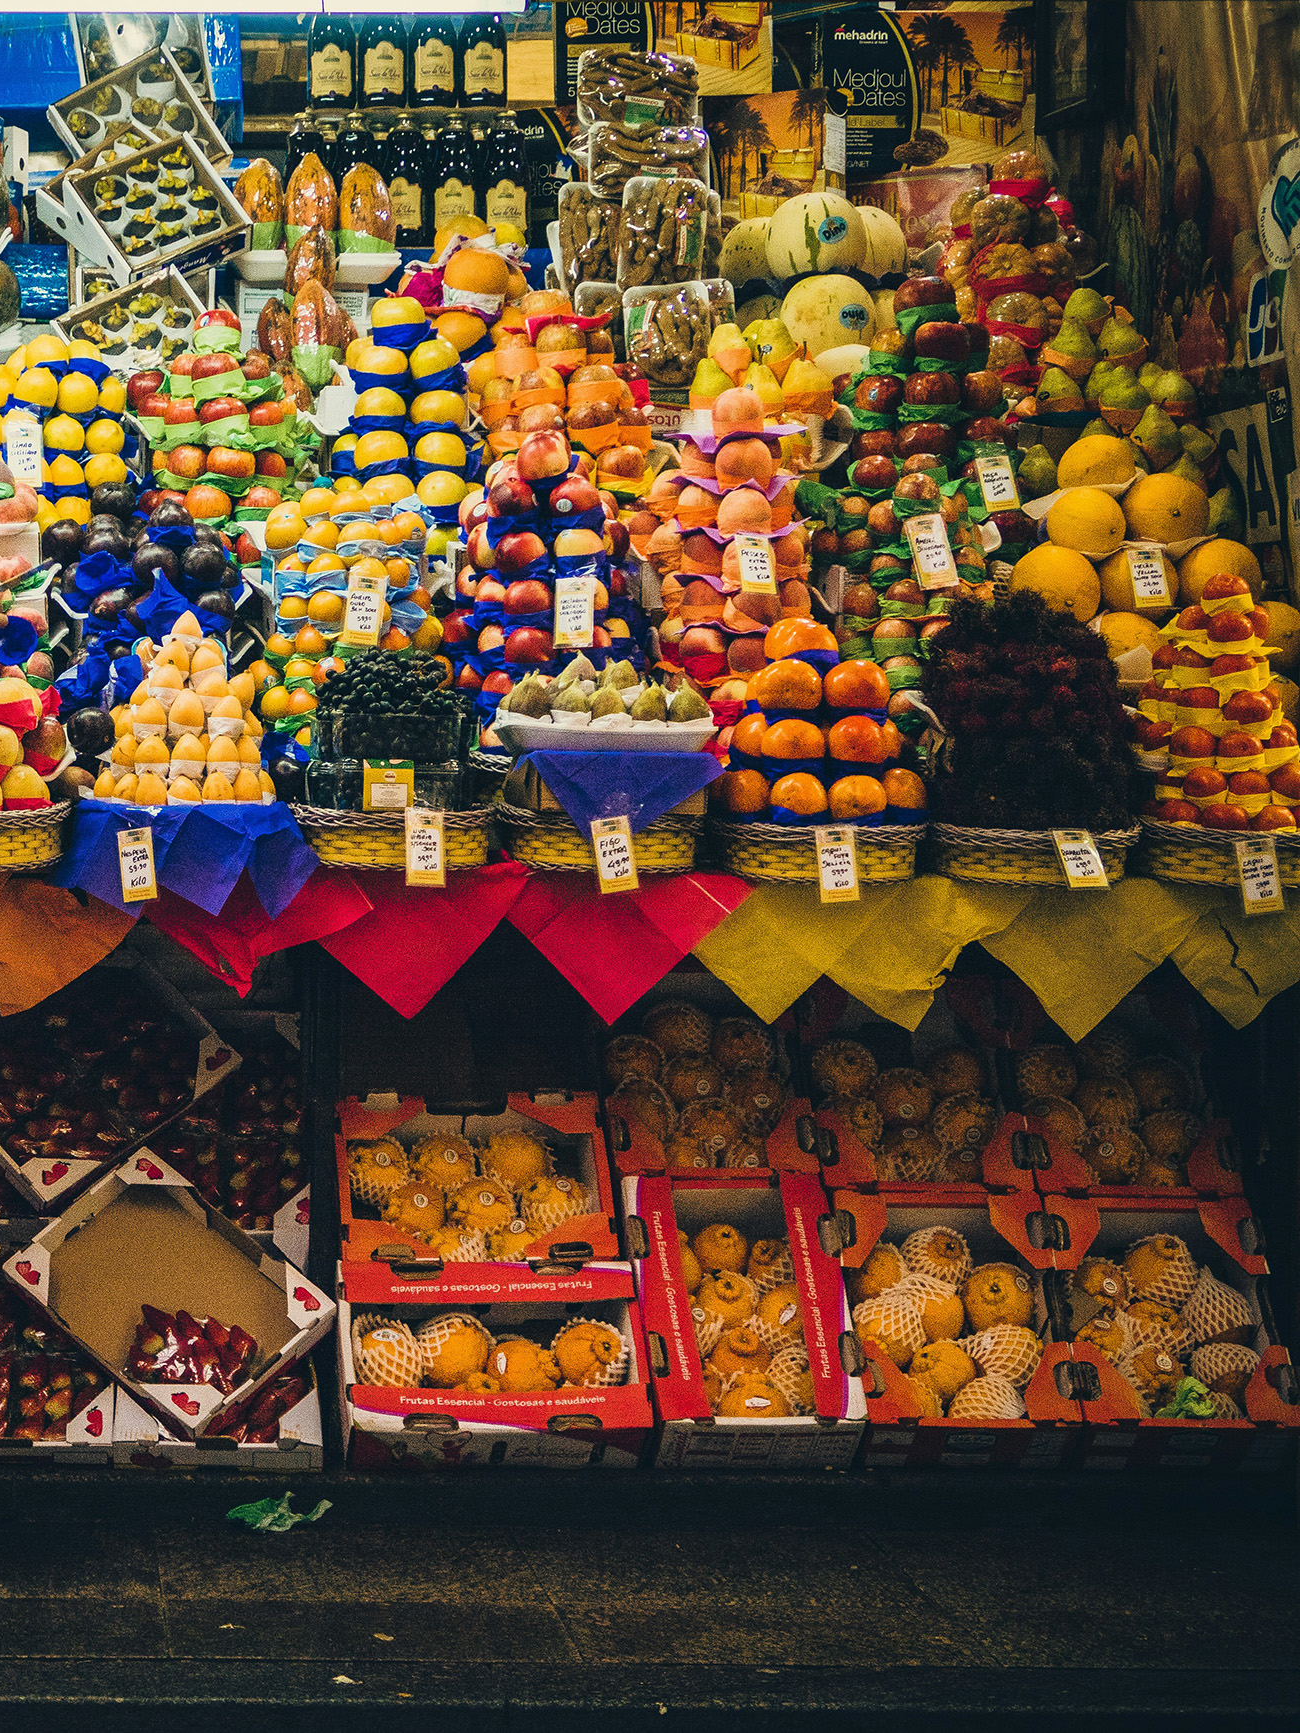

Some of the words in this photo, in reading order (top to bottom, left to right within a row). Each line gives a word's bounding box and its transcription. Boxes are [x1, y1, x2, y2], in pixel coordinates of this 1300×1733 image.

[586, 16, 640, 35] Dates
[834, 29, 889, 41] mehadrin
[833, 69, 906, 92] Medjoul
[851, 88, 906, 107] Dates
[822, 222, 846, 241] Dino
[841, 310, 865, 321] Dino
[600, 837, 620, 848] FIGO
[602, 845, 628, 857] EXTRA
[652, 1210, 664, 1240] Frutas
[793, 1207, 809, 1250] saudáveis
[657, 1240, 673, 1281] Essencial
[509, 1282, 557, 1293] Essencial
[558, 1280, 593, 1290] Frutas
[804, 1256, 818, 1300] Gostosas
[390, 1284, 440, 1295] saudáveis
[450, 1284, 500, 1293] Gostosas
[665, 1287, 681, 1329] Gostosas
[810, 1306, 827, 1348] Essencial
[675, 1338, 692, 1381] saudáveis
[820, 1350, 832, 1379] Frutas
[400, 1396, 435, 1405] Frutas
[436, 1397, 485, 1406] Essencial
[494, 1399, 544, 1407] Gostosas
[555, 1396, 605, 1405] saudáveis
